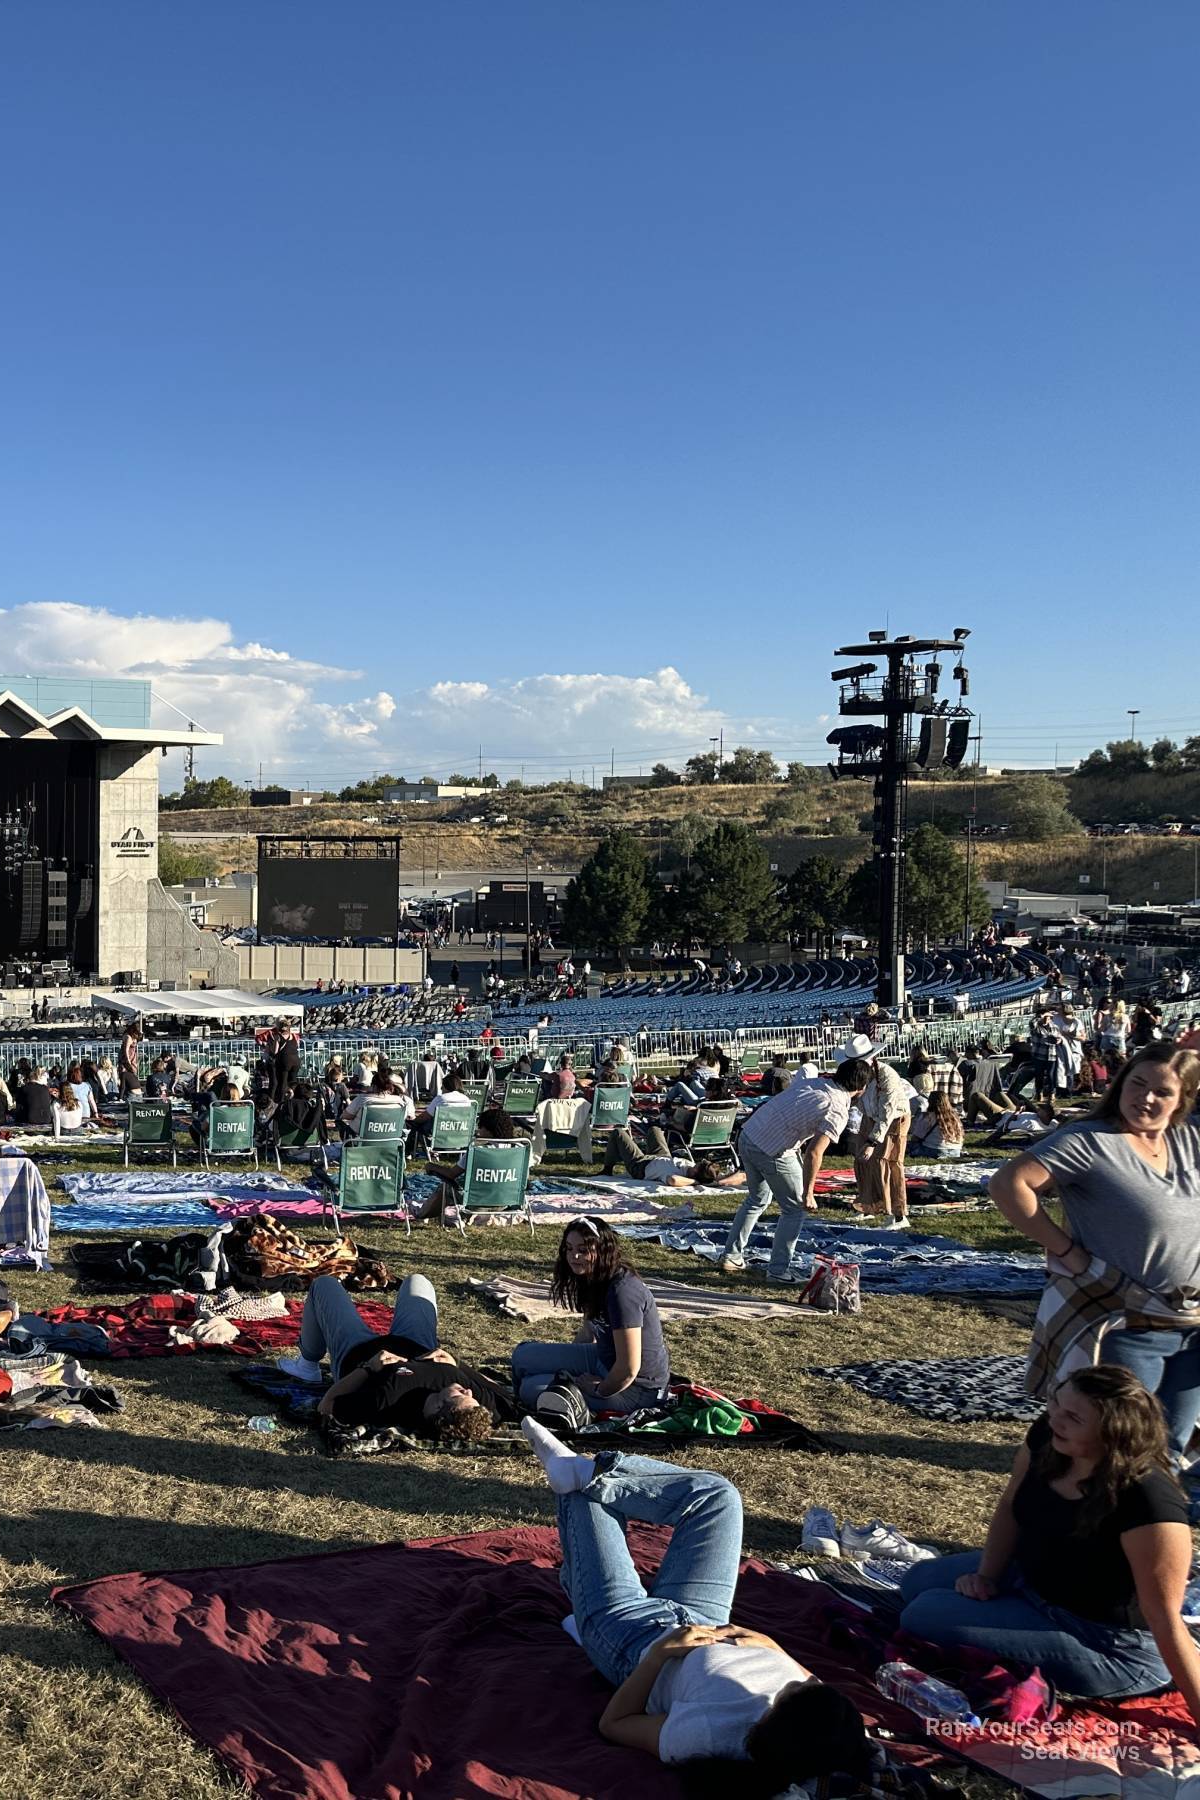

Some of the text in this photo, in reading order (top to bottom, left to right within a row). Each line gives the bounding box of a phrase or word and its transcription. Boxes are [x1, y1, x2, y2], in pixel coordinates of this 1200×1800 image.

[600, 1101, 624, 1110] RENTAL
[136, 1109, 165, 1117] RENTAL
[702, 1115, 730, 1123] RENTAL
[217, 1122, 247, 1132] RENTAL
[368, 1121, 397, 1132] RENTAL
[440, 1121, 468, 1131] RENTAL
[350, 1165, 392, 1181] RENTAL
[475, 1168, 518, 1183] RENTAL
